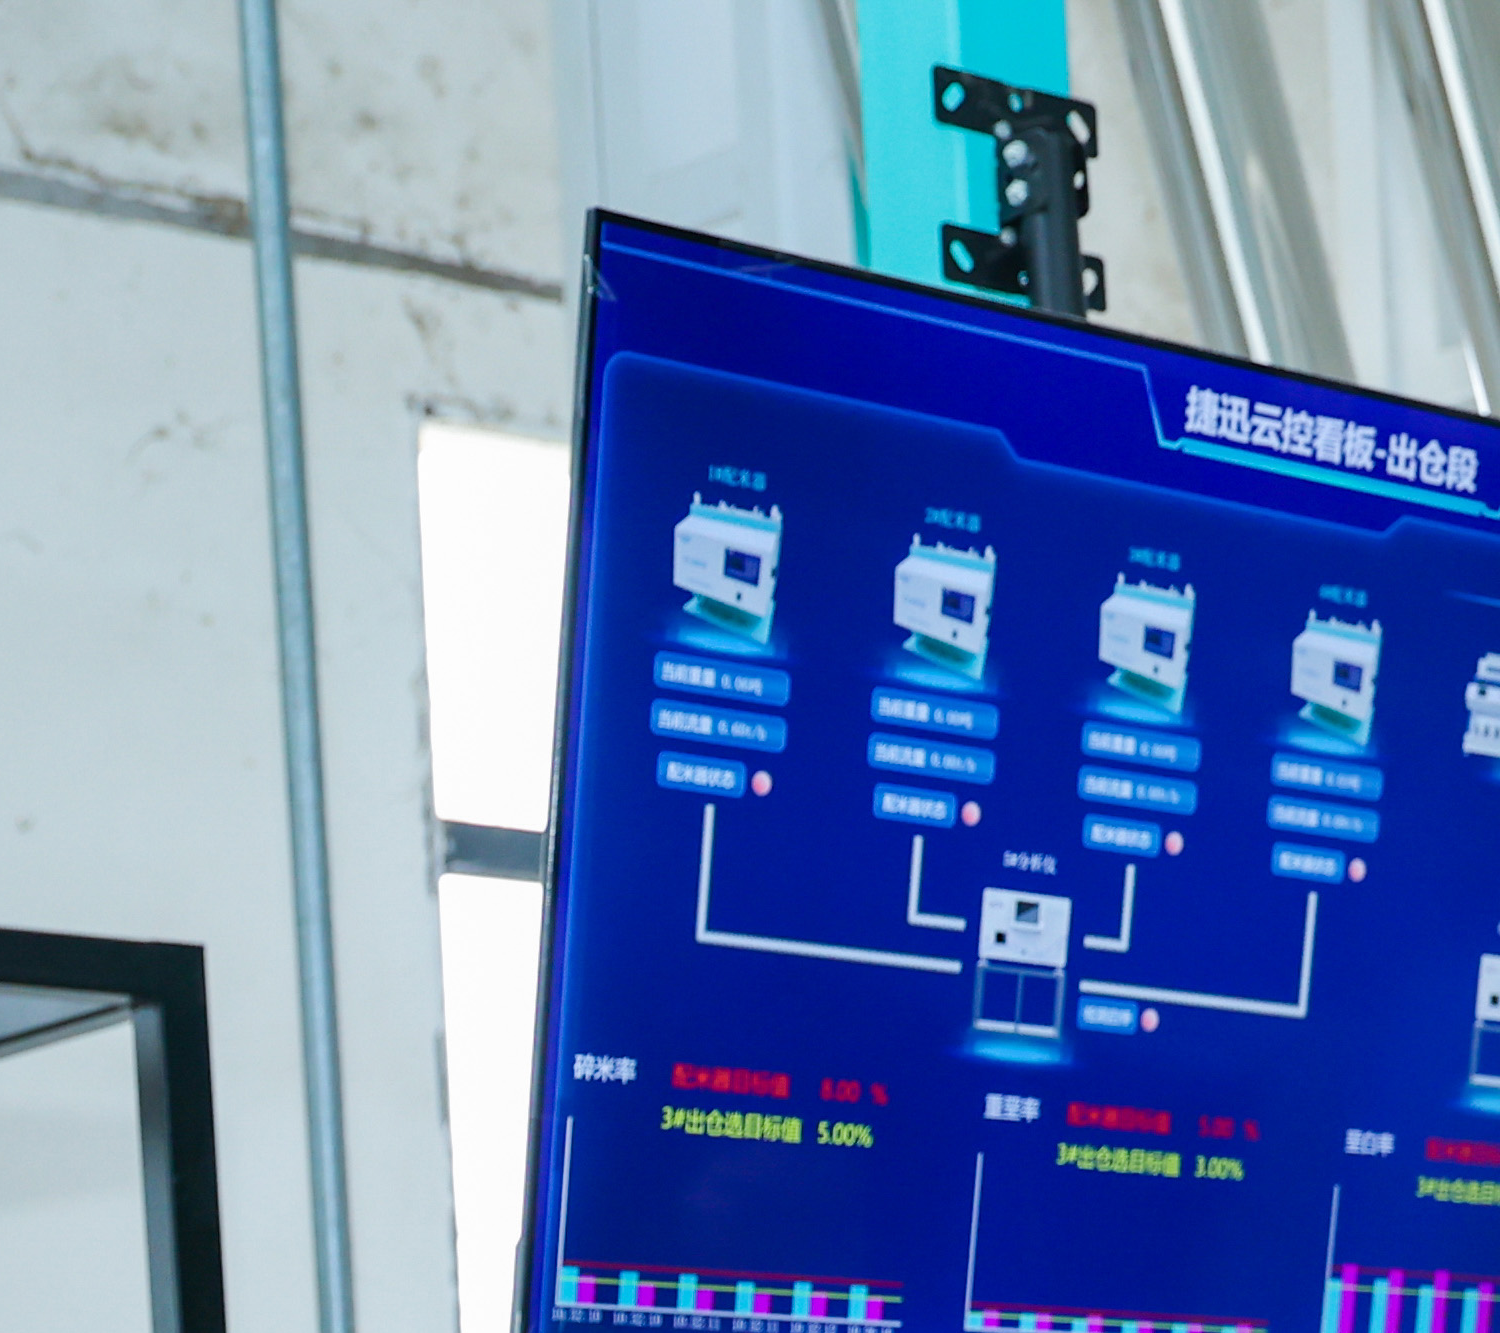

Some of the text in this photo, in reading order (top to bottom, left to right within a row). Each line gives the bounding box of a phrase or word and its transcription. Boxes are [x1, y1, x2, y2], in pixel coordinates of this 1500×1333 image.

[1184, 384, 1479, 493] 捷迅云控看板-出仓段
[574, 1053, 637, 1084] 碎米率
[661, 1105, 874, 1149] 3#出仓选目标值 5.00%
